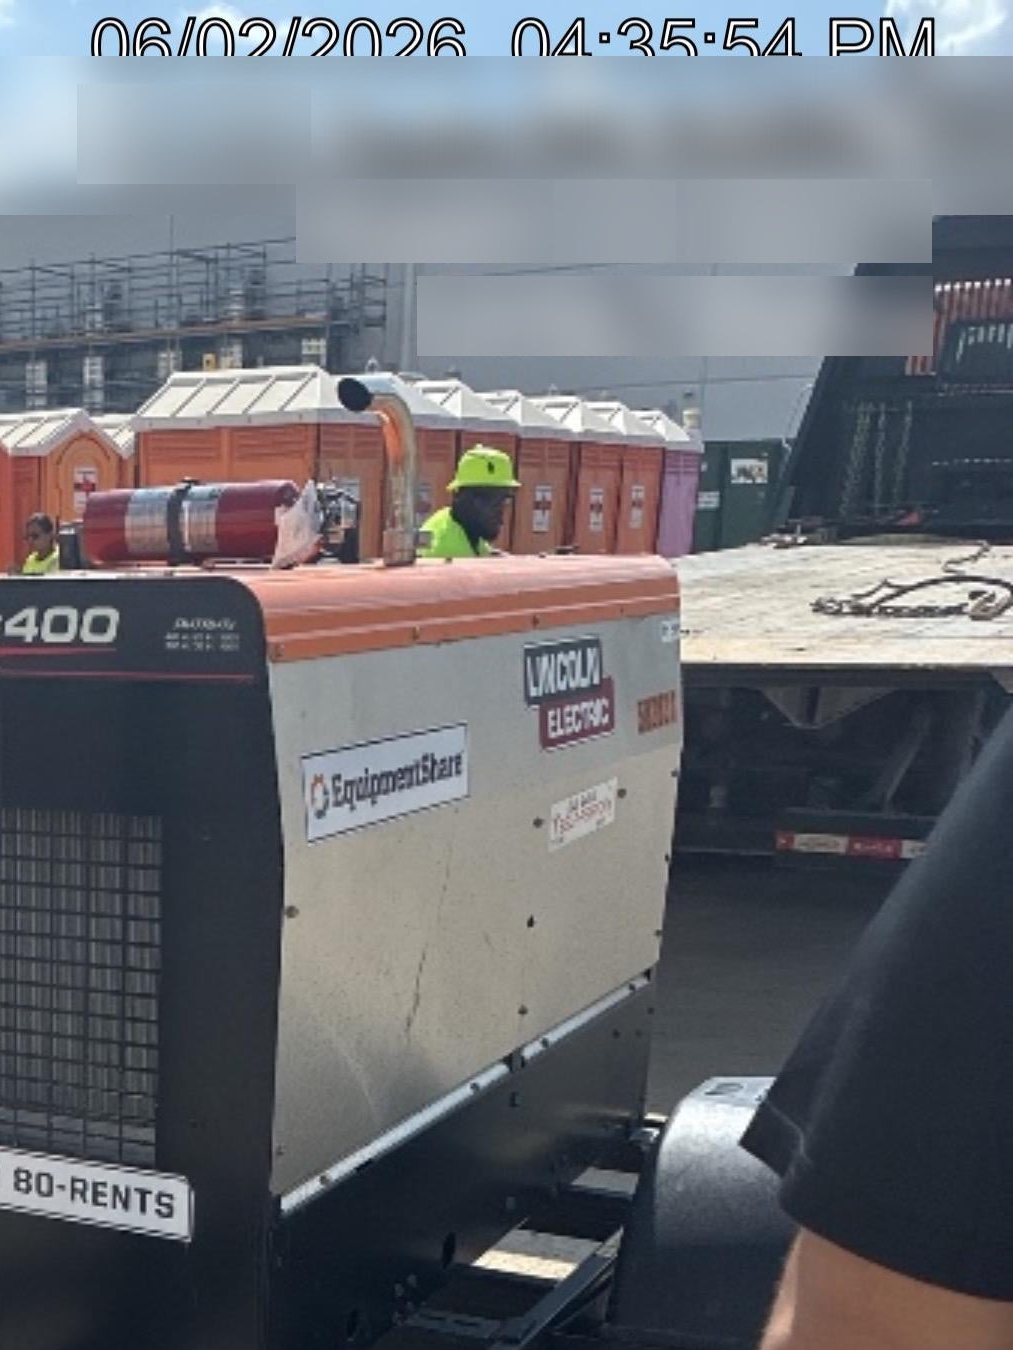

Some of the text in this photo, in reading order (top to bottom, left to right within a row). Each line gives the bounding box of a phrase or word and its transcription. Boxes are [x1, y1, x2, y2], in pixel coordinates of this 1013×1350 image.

[526, 647, 600, 697] LINCOLN
[547, 697, 610, 739] ELECTRIC
[331, 752, 463, 815] EquipmentShare
[13, 1166, 175, 1219] 80-RENTS
